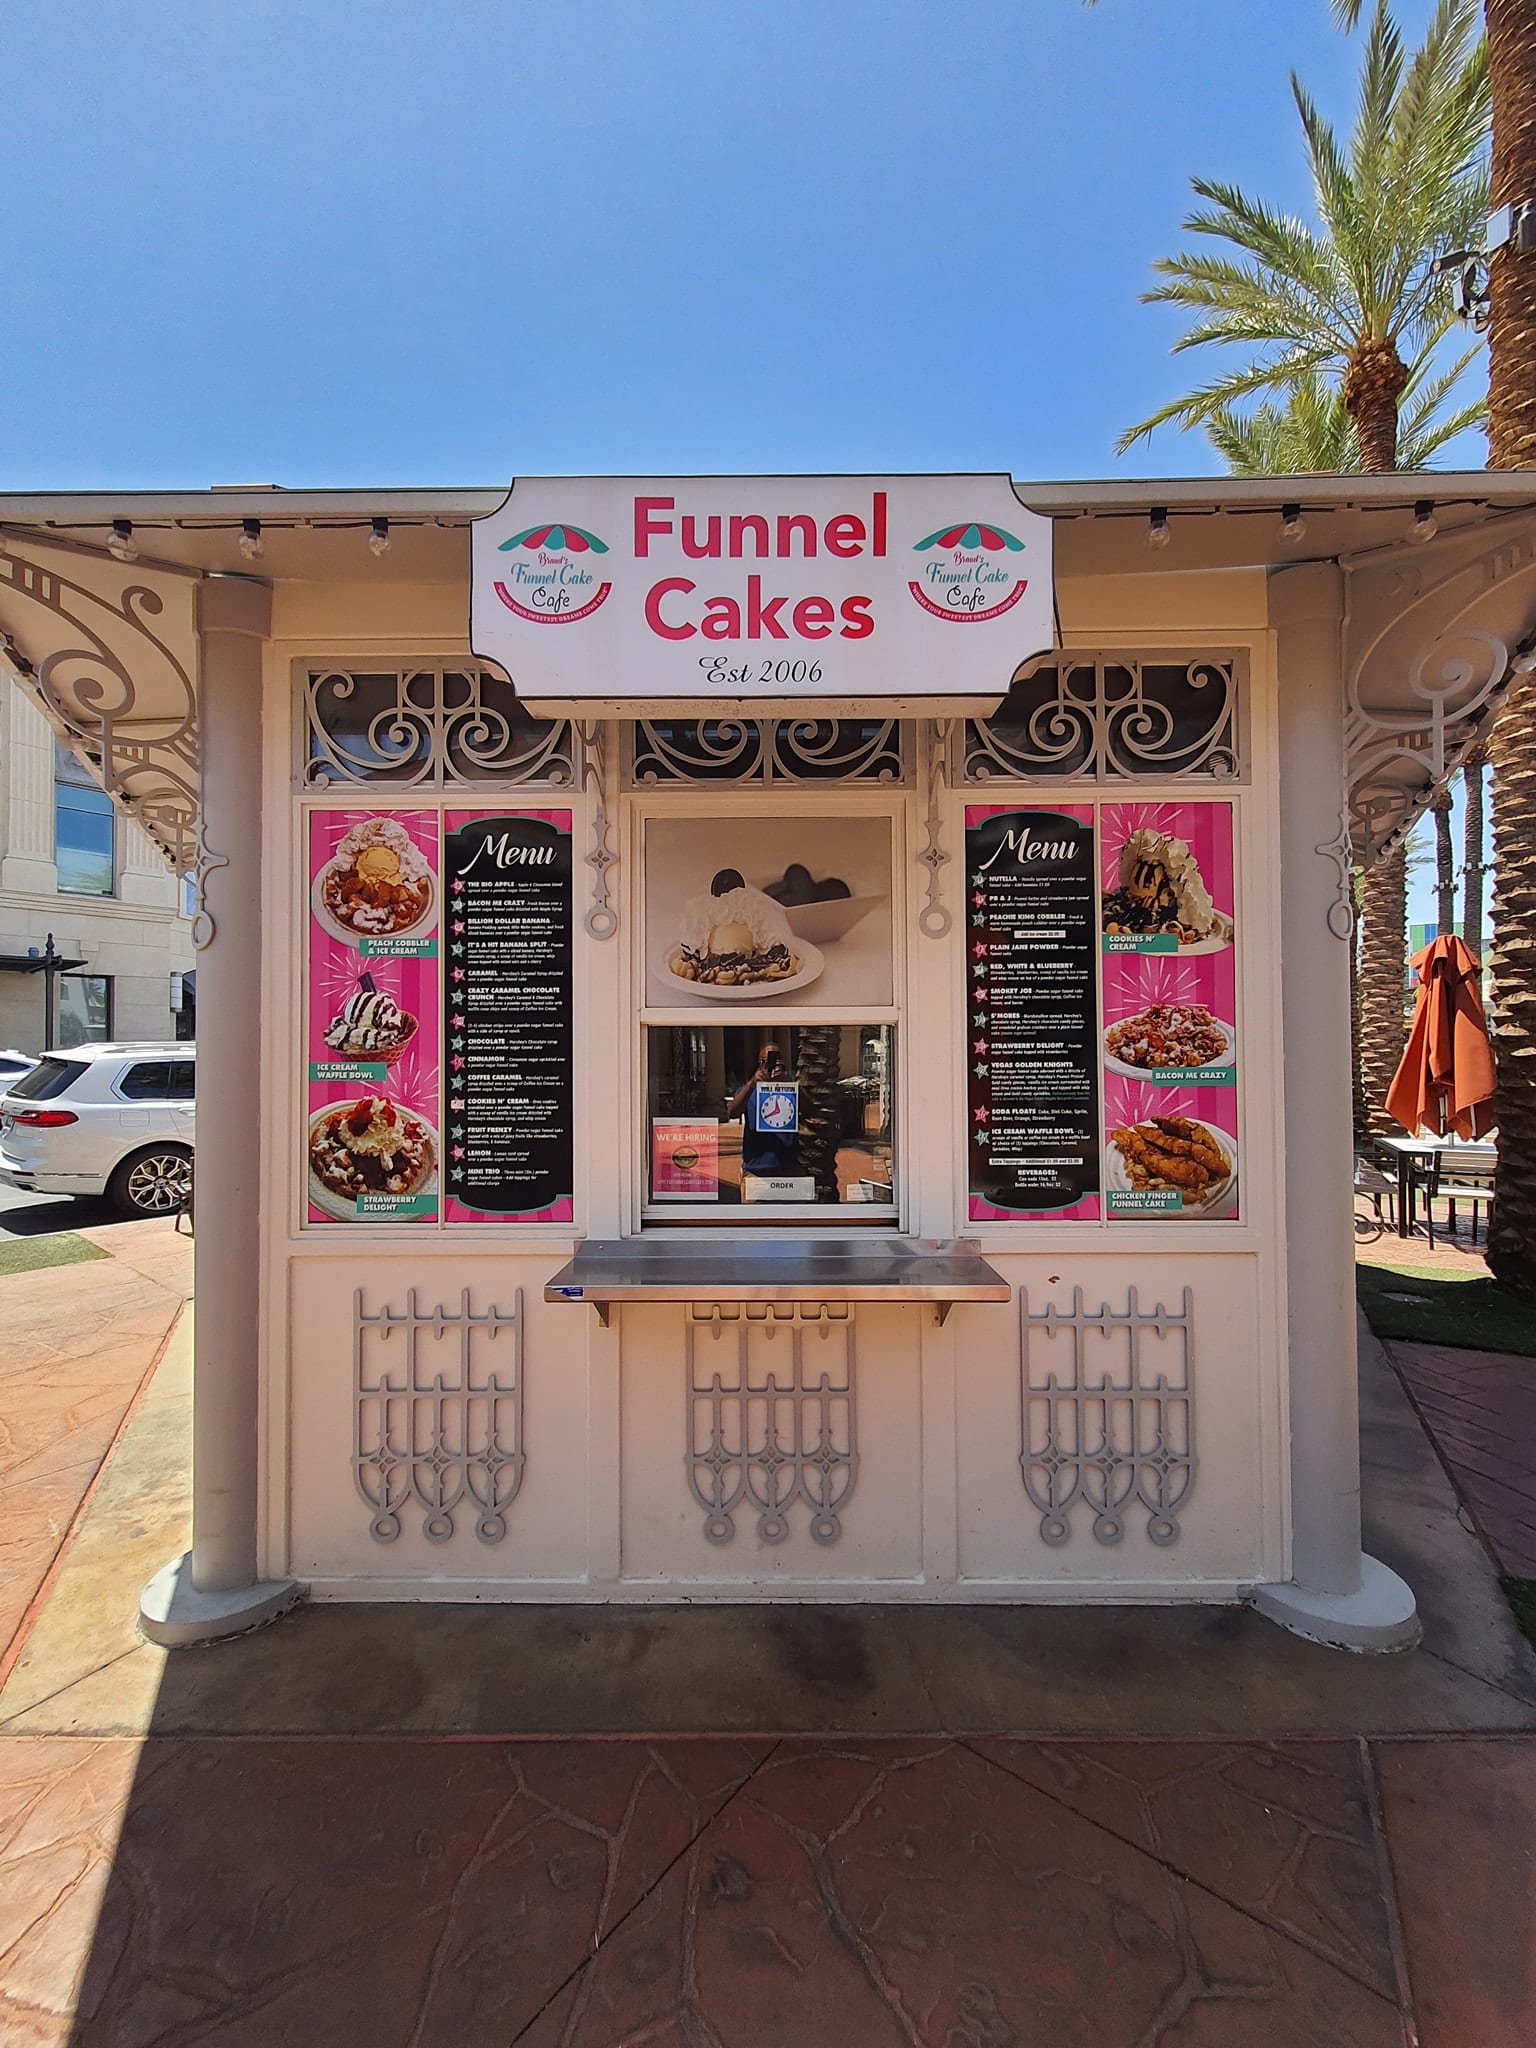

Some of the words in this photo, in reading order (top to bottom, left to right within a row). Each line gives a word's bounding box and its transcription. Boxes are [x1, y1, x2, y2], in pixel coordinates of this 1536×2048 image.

[633, 492, 886, 558] Funnel
[511, 562, 557, 584] Funnel
[560, 564, 593, 585] Cake
[925, 561, 972, 584] Funnel
[975, 562, 1009, 584] Cake
[532, 586, 570, 613] Cafe
[645, 575, 875, 641] Cakes
[947, 585, 985, 611] Cafe
[527, 613, 558, 622] SWEETEST
[559, 611, 583, 622] DREAMS
[583, 603, 598, 615] COME
[942, 611, 973, 621] SWEETEST
[974, 609, 998, 621] DREAMS
[998, 601, 1013, 613] COME
[698, 656, 753, 684] Est
[758, 658, 823, 684] 2006
[457, 833, 557, 875] Menu
[978, 827, 1080, 871] Menu
[1109, 935, 1144, 943] COOKIES
[368, 947, 374, 955] &
[376, 947, 388, 955] ICE
[390, 947, 418, 955] CREAM
[1155, 1072, 1184, 1080] BACON
[657, 1133, 684, 1141] WE'RE
[363, 1196, 416, 1204] STRAWBERRY
[1112, 1200, 1144, 1208] FUNNEL
[1148, 1192, 1177, 1200] FINGER
[363, 1204, 397, 1212] DELIGHT
